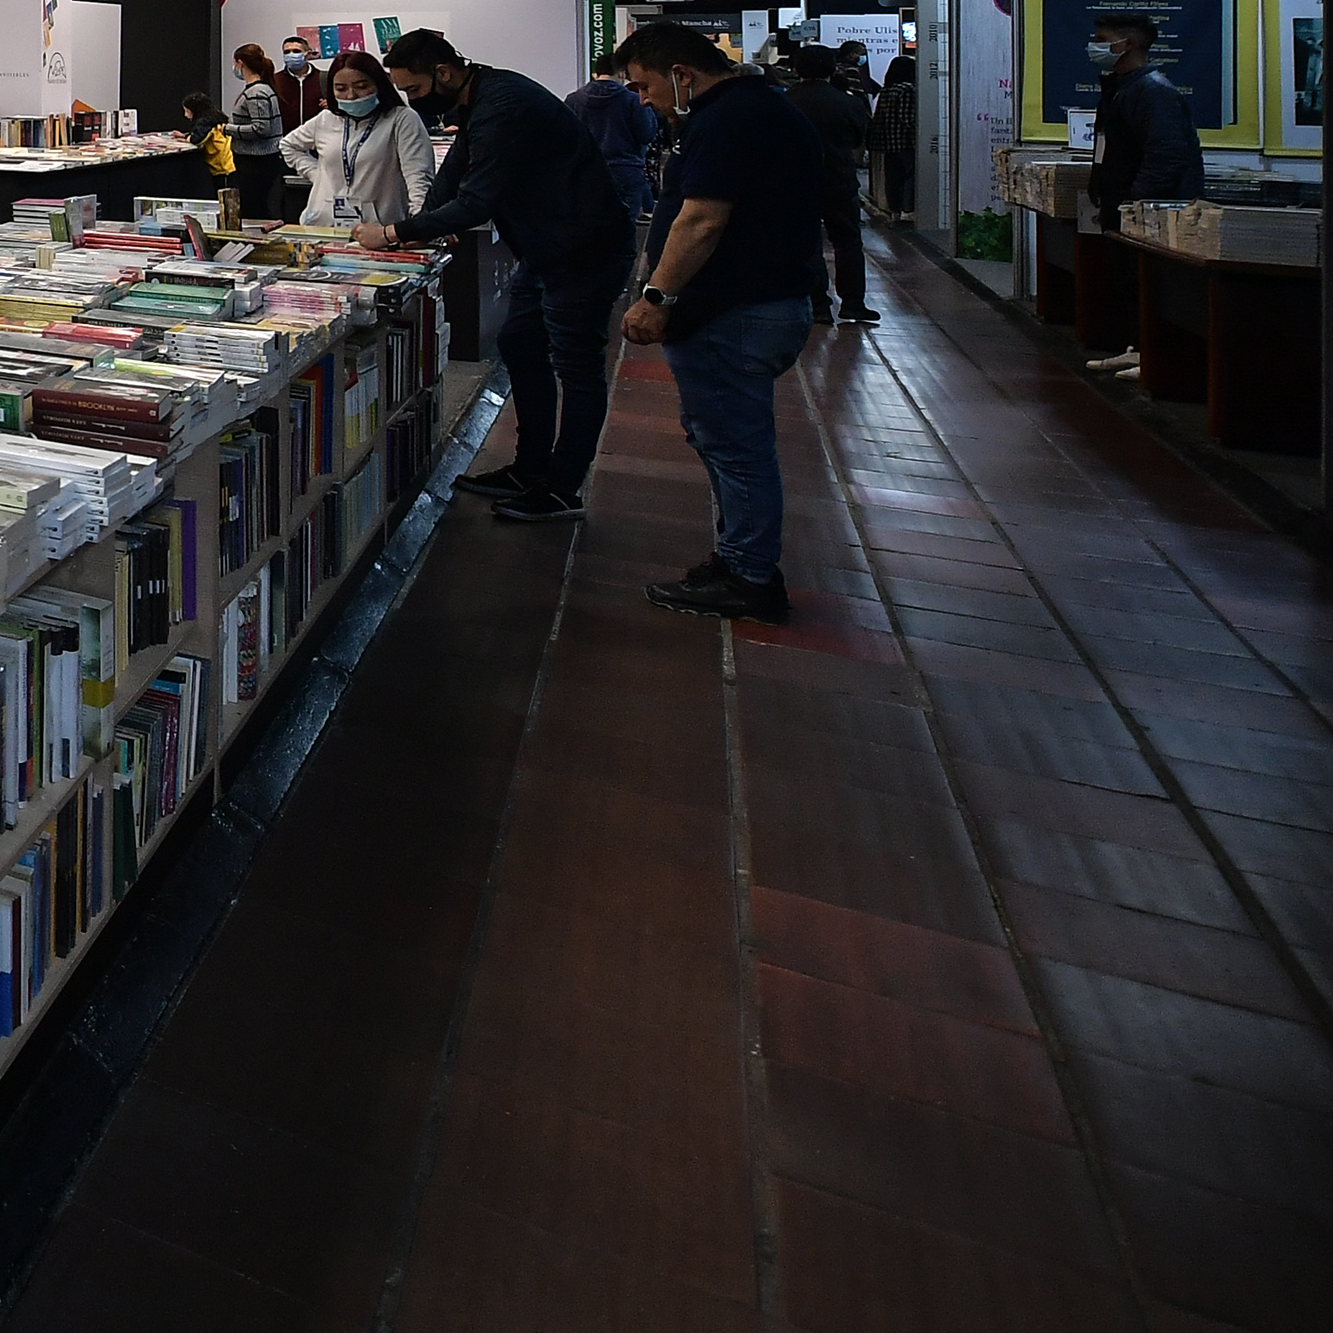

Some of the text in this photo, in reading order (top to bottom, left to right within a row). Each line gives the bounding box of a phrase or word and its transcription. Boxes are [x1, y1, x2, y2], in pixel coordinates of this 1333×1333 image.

[837, 25, 897, 35] Pobre Ulis
[876, 47, 896, 56] por
